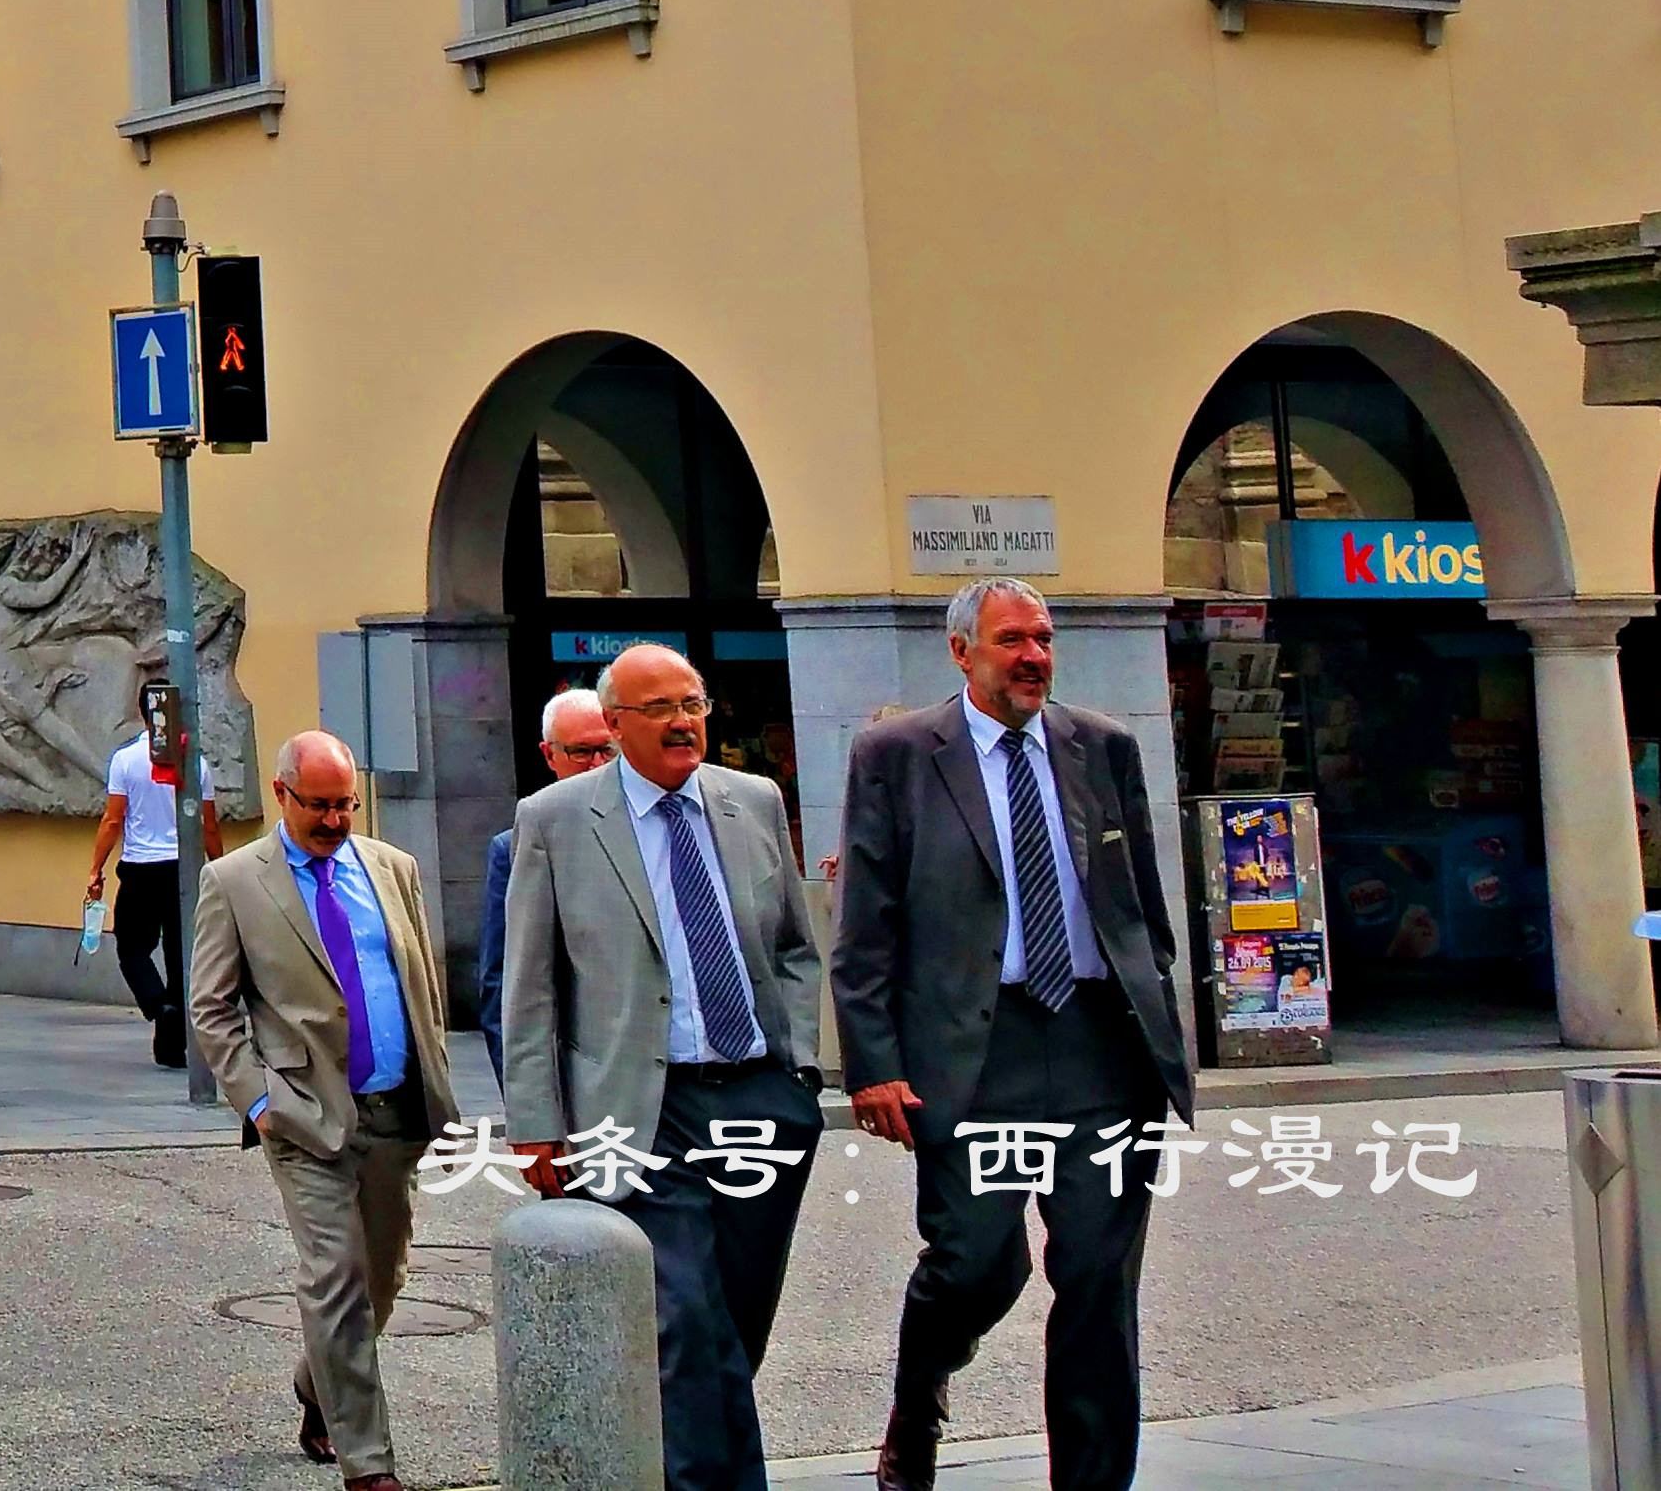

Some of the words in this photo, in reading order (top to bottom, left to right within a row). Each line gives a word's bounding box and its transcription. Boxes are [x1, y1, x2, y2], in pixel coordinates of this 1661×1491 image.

[972, 504, 992, 524] VIA
[912, 530, 998, 551] MASSIMILIANO
[1004, 531, 1054, 551] MAGATTI
[1342, 531, 1377, 584] k
